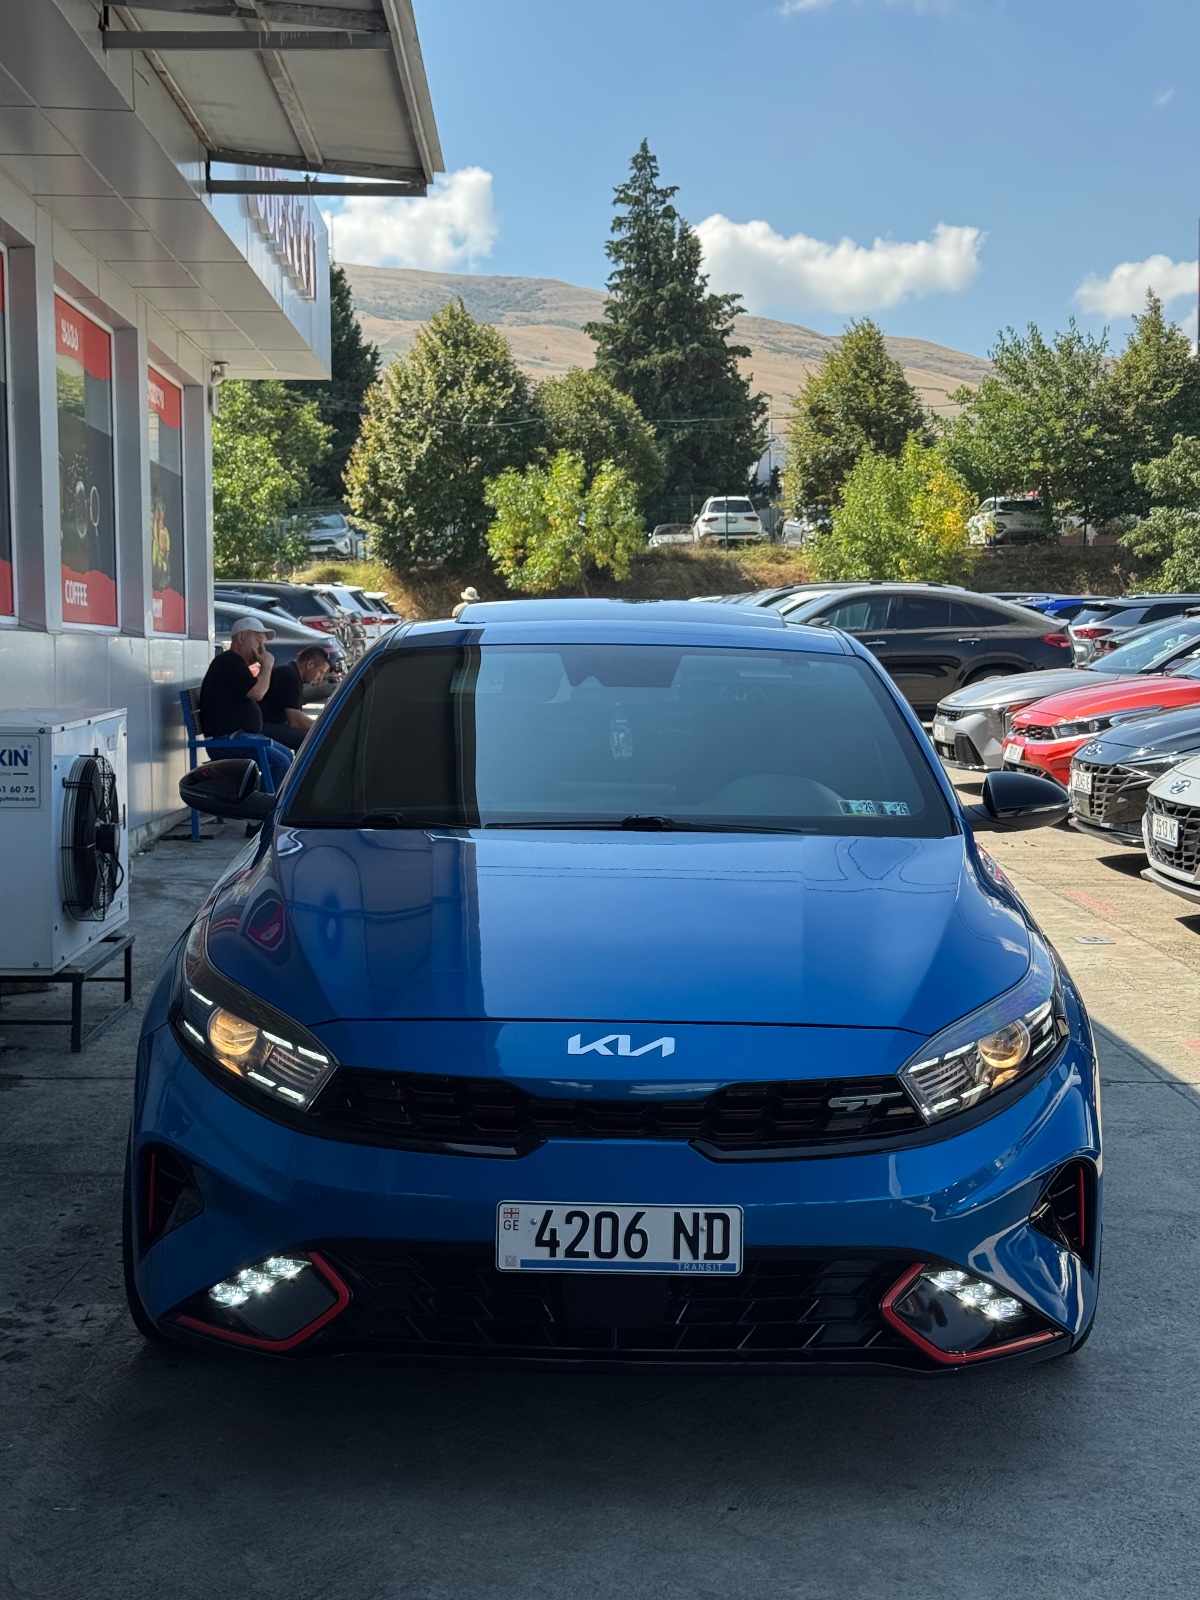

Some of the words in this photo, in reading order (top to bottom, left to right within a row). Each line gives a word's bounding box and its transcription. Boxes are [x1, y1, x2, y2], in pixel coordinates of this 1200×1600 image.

[65, 579, 88, 606] COFFEE
[10, 785, 21, 793] 60
[23, 785, 35, 793] 75
[567, 1033, 675, 1058] KIA
[828, 1091, 903, 1111] GT
[503, 1219, 520, 1231] GE
[534, 1209, 649, 1260] 4206
[672, 1211, 731, 1261] ND
[677, 1262, 723, 1272] TRANSIT
